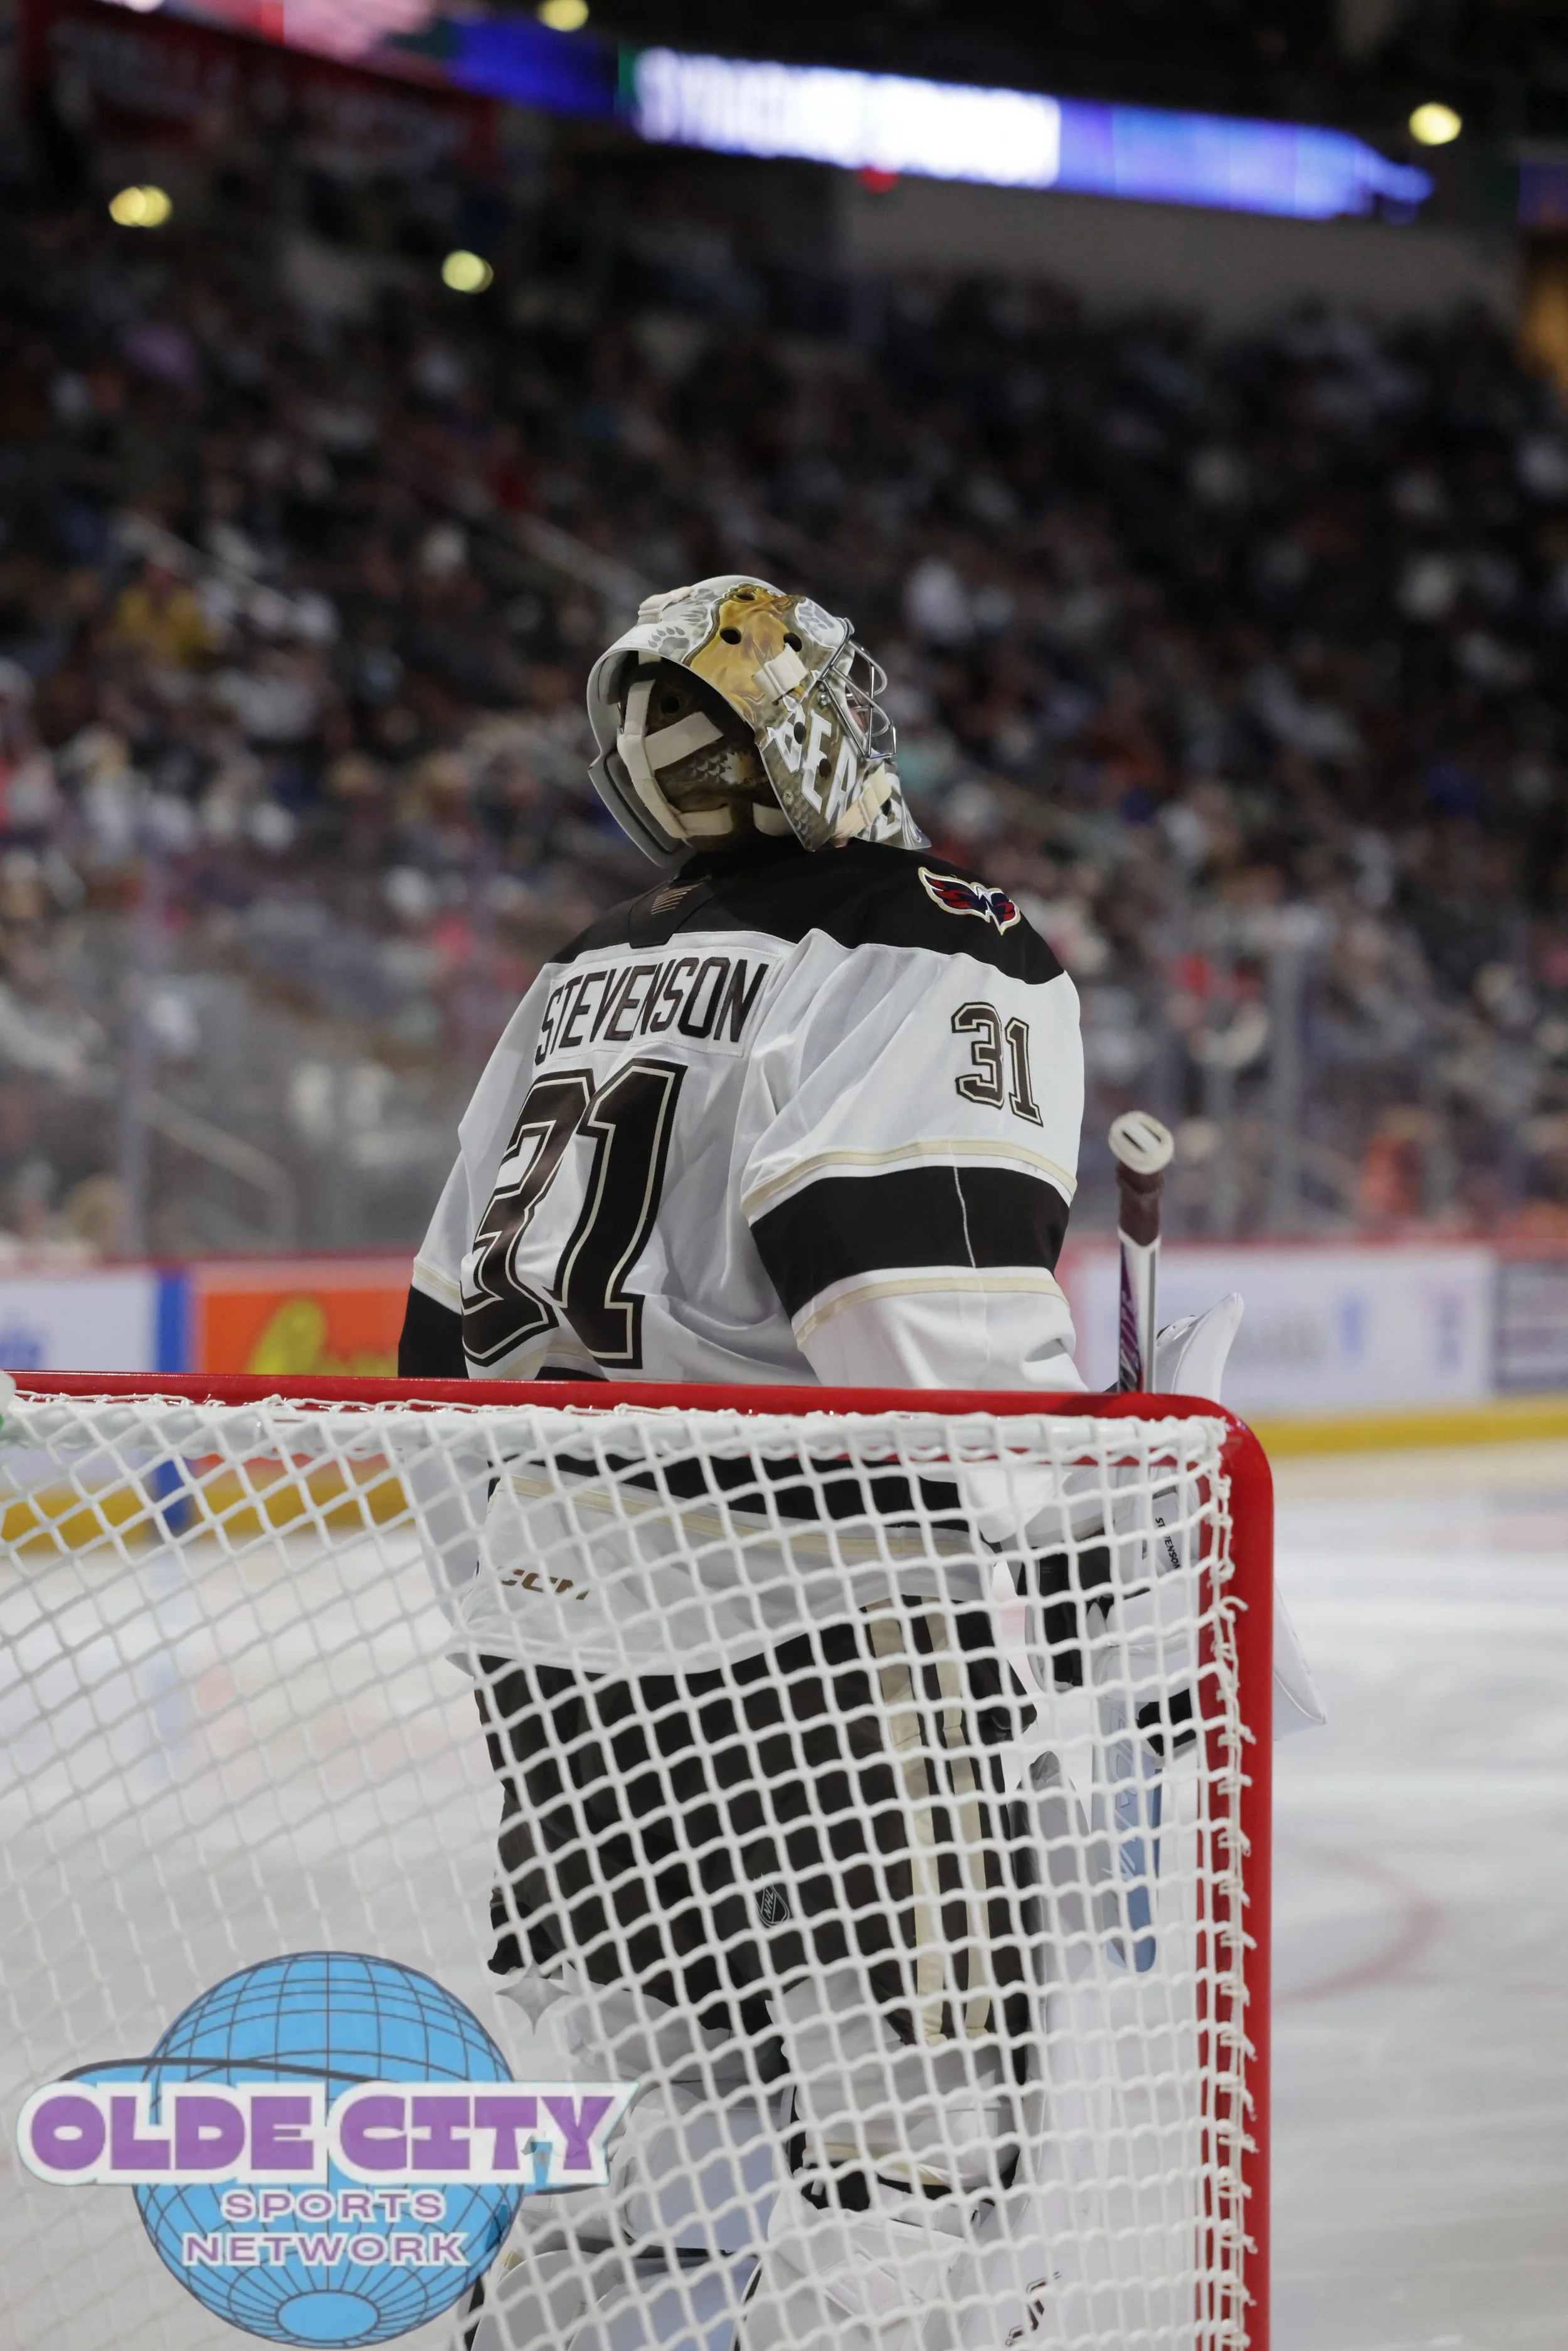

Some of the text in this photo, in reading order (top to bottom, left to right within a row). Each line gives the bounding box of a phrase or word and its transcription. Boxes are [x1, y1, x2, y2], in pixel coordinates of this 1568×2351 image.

[535, 957, 769, 1066] STEVENSON
[951, 1001, 1043, 1127] 31
[460, 1058, 689, 1370] 31
[762, 1888, 775, 1919] NHL
